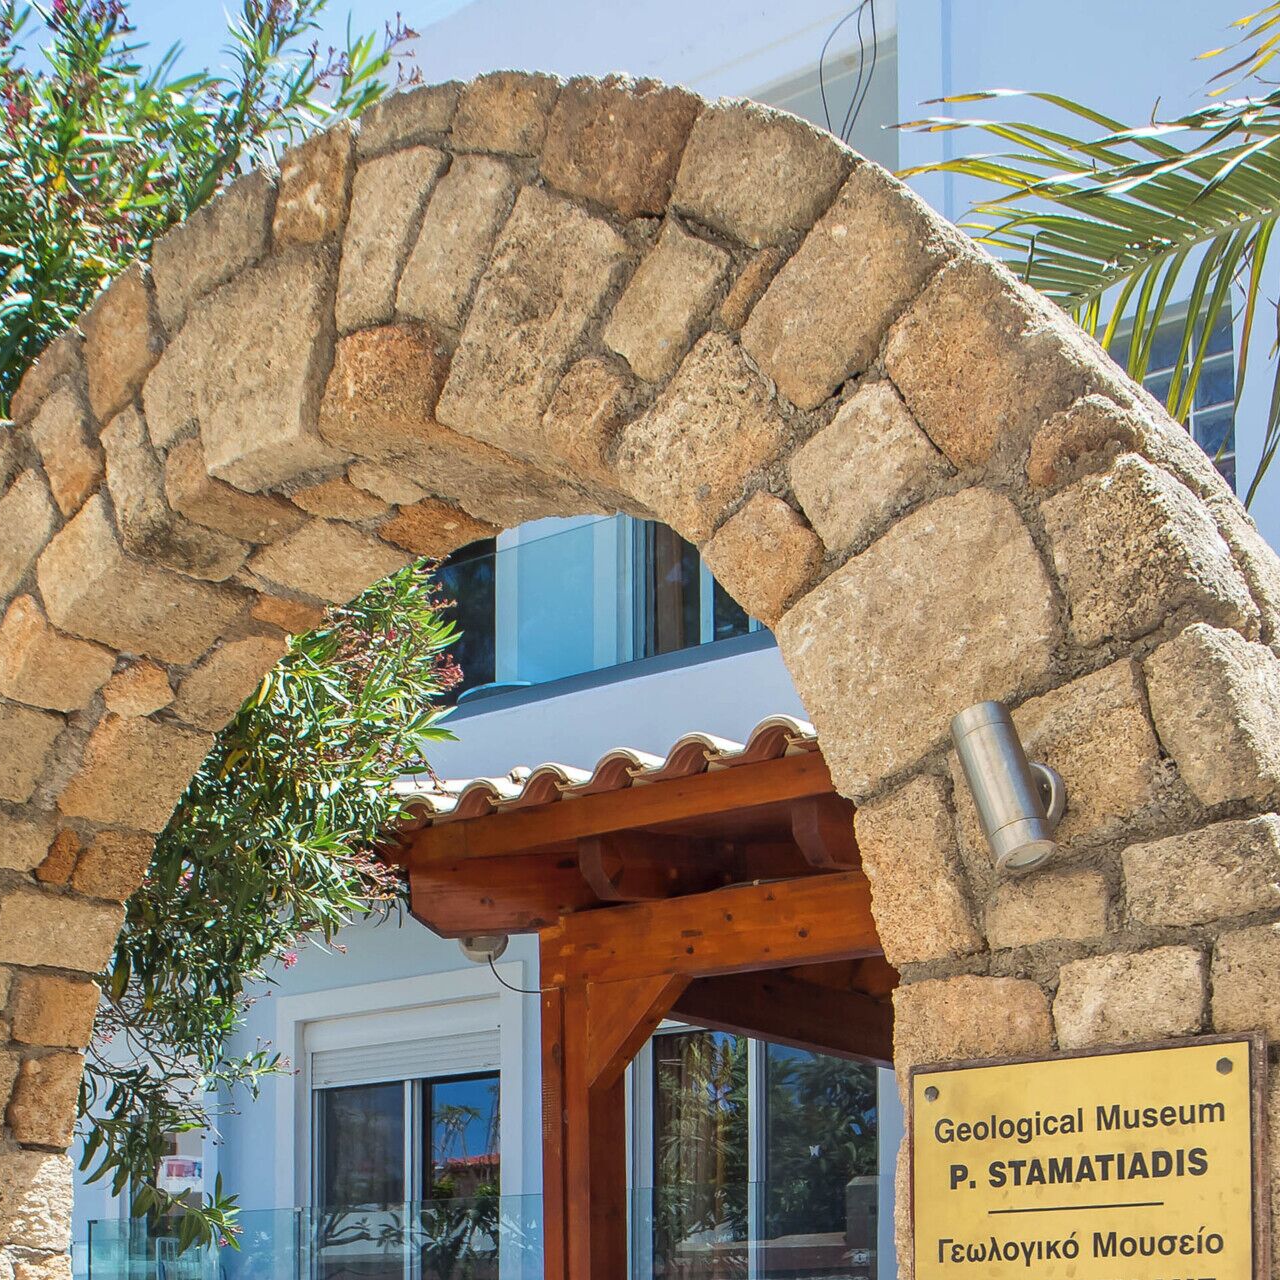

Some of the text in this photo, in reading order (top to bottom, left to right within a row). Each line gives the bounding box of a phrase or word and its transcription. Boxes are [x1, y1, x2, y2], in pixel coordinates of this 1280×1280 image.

[934, 1102, 1225, 1144] Geological Museum
[950, 1147, 1208, 1190] P. STAMATIADIS
[938, 1225, 1224, 1268] Γεωλογικό Μουσείο
